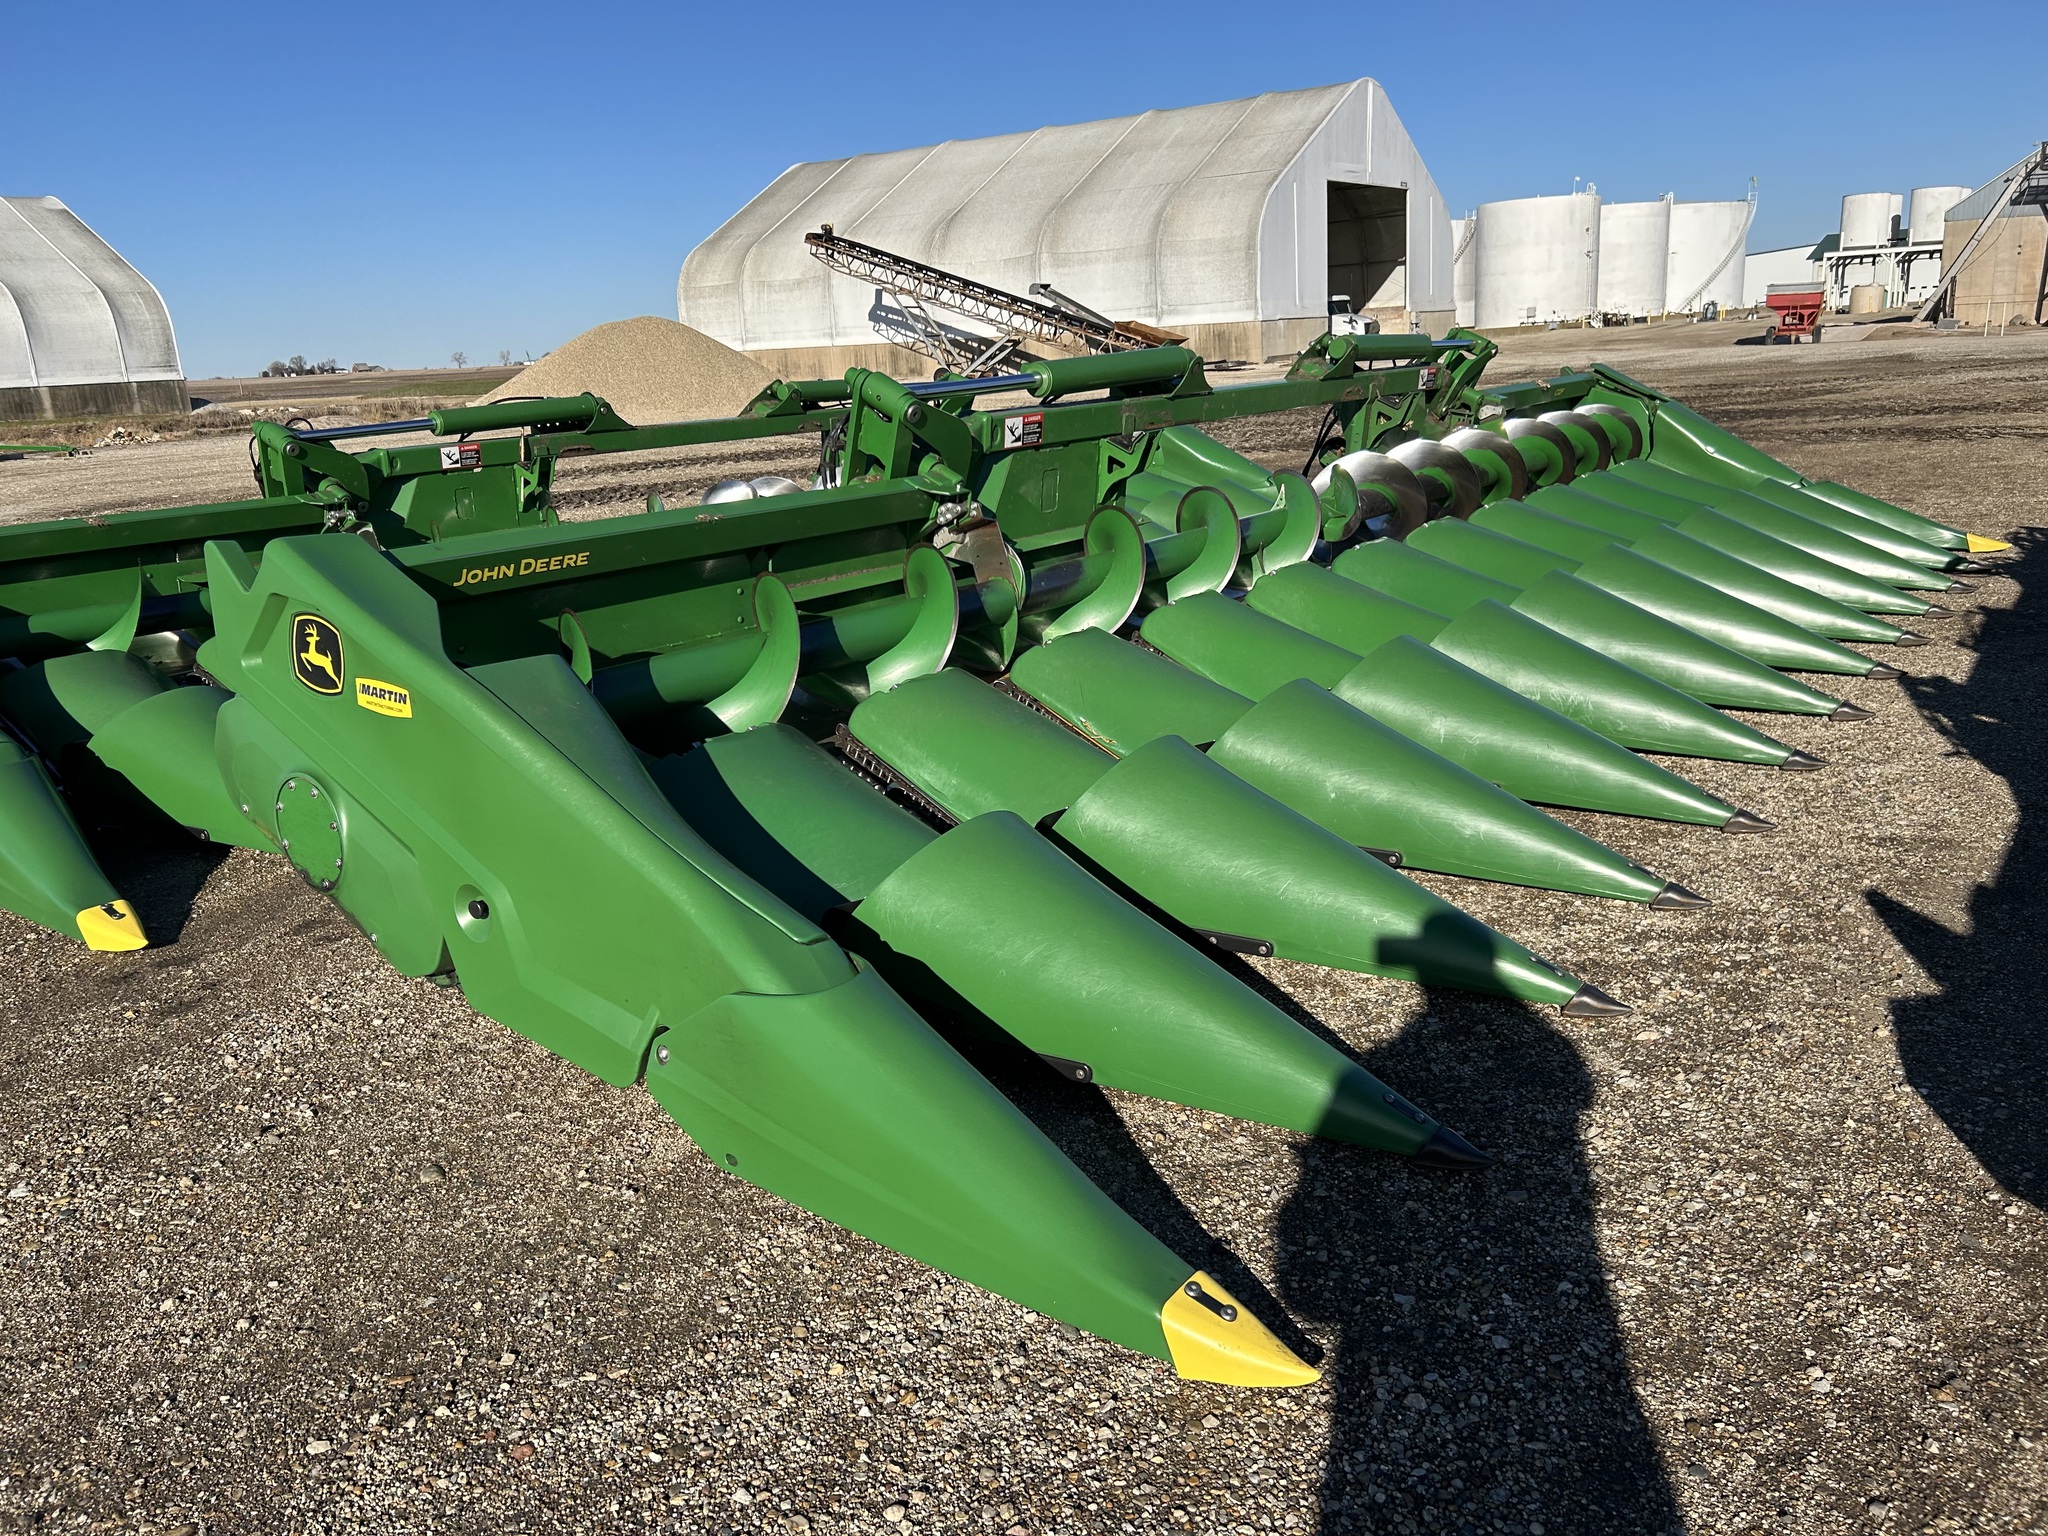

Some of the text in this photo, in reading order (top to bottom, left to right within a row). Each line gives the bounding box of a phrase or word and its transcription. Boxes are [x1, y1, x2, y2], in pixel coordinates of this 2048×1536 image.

[453, 552, 590, 587] JOHN DEERE
[361, 683, 407, 705] MARTIN
